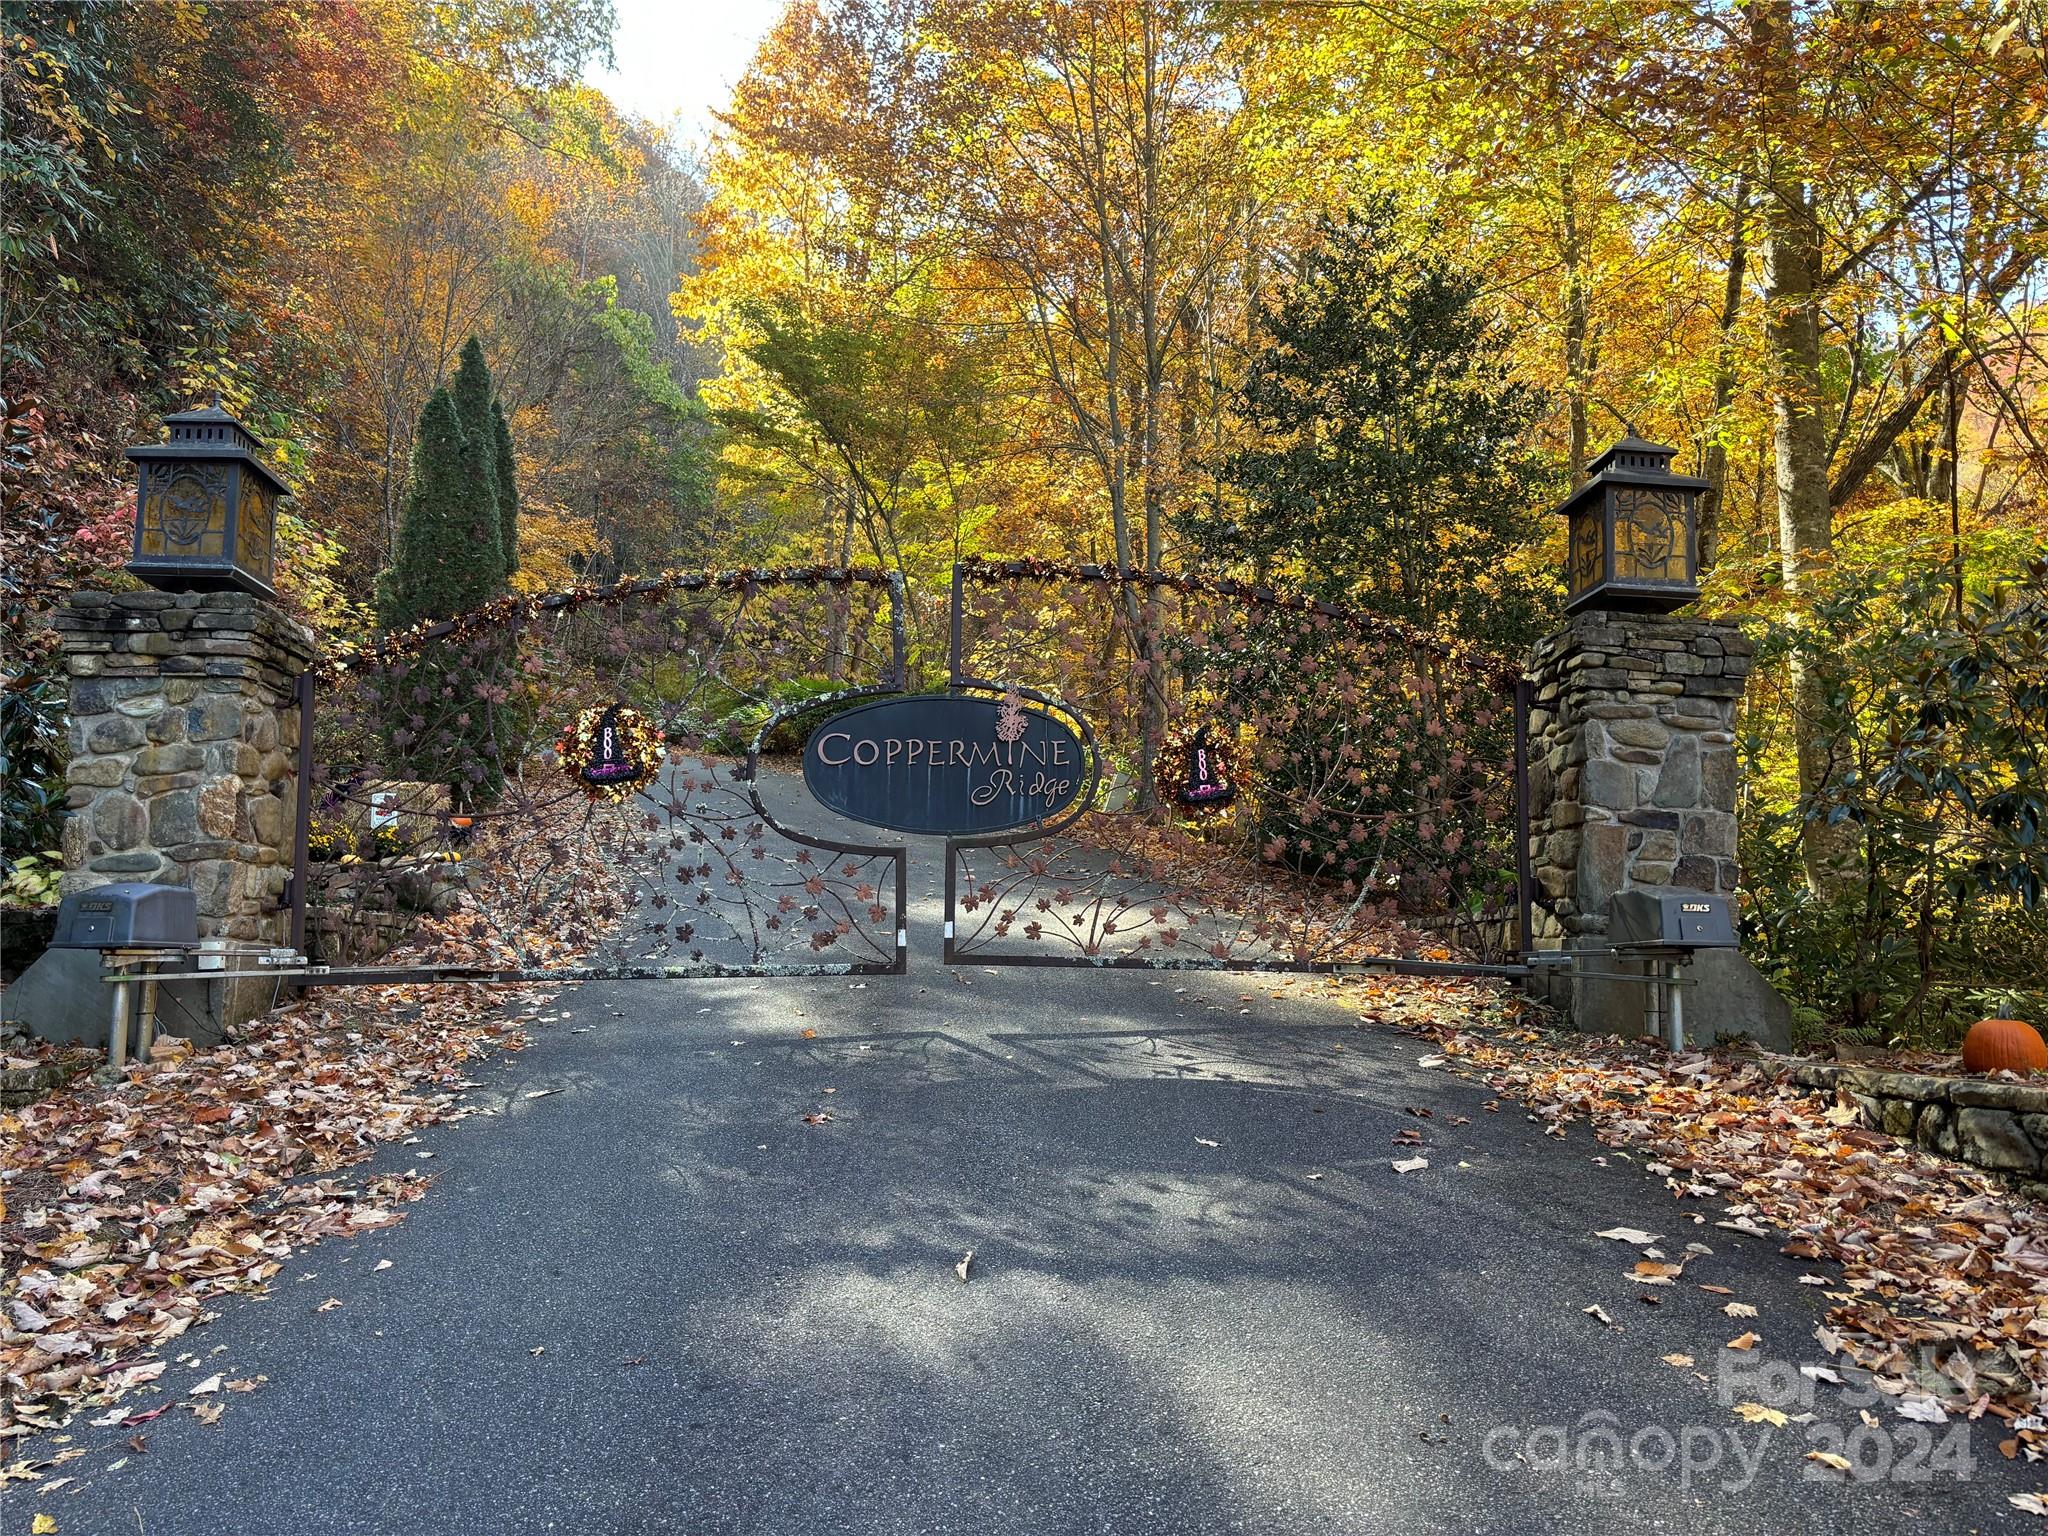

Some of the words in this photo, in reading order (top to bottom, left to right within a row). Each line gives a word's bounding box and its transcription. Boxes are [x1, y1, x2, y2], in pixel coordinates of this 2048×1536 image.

[603, 726, 613, 760] BOO
[817, 732, 1071, 768] COPPERMINE
[1197, 748, 1208, 781] BOO
[970, 768, 1071, 807] Ridge
